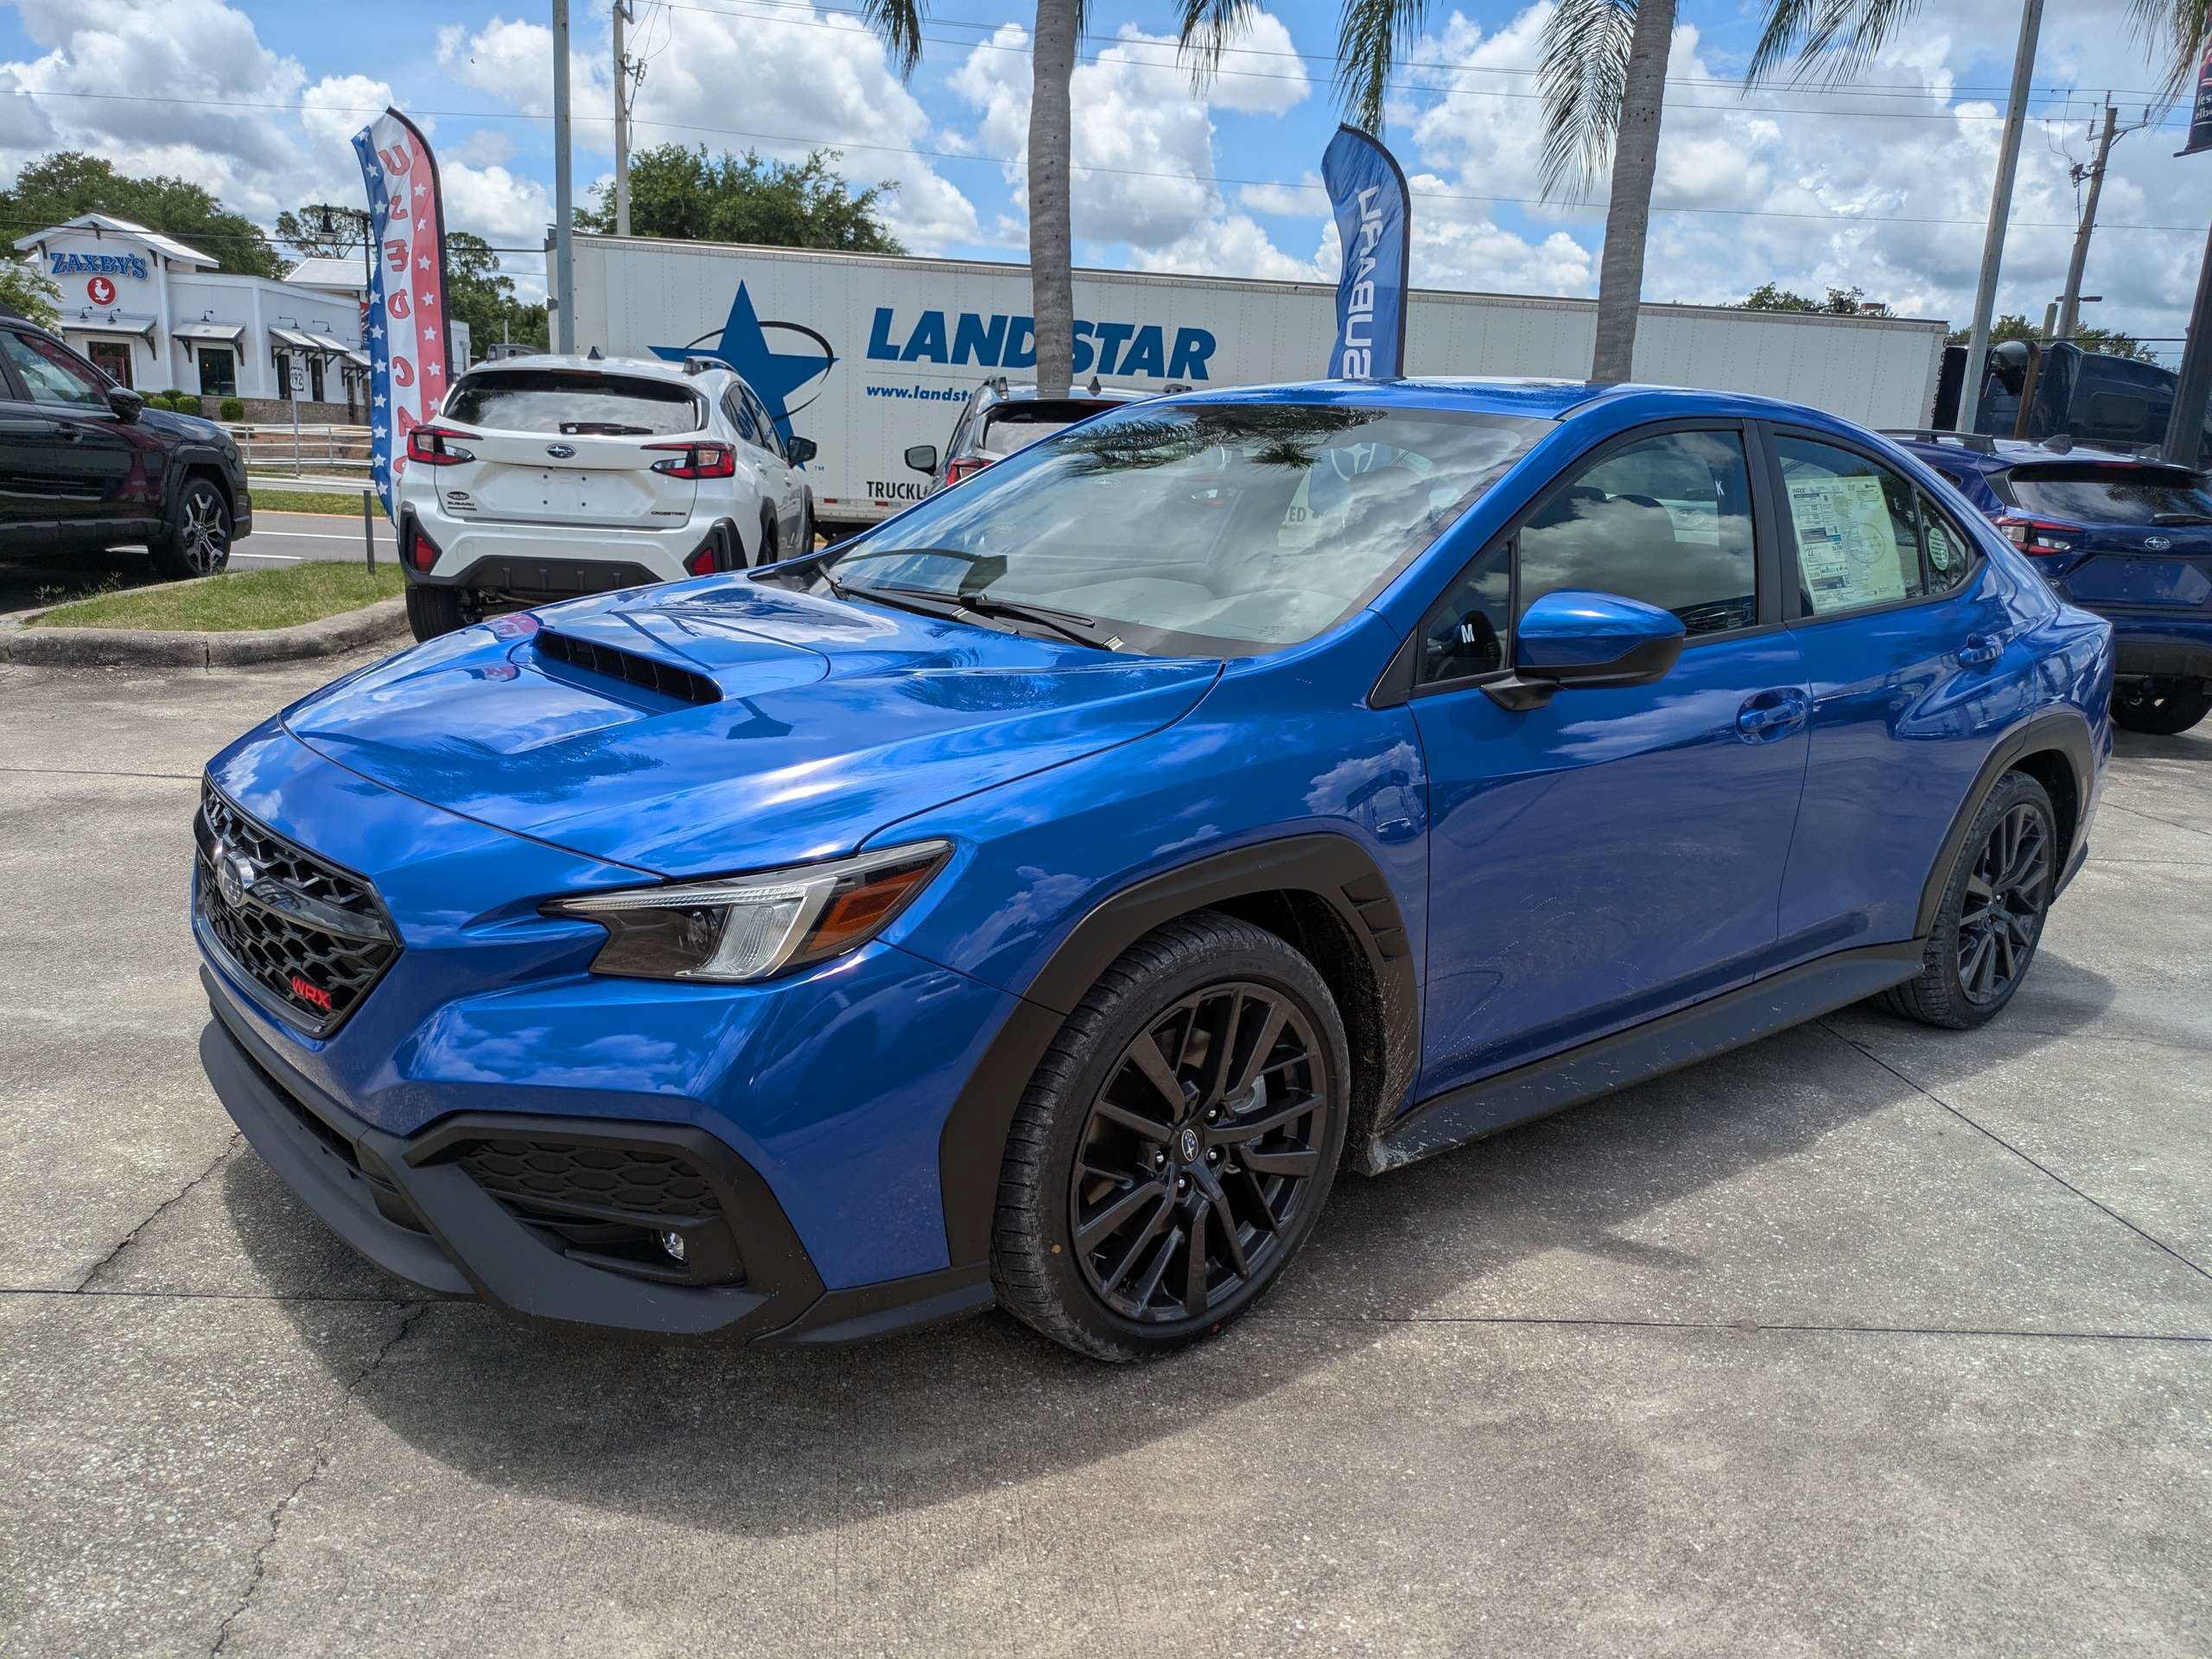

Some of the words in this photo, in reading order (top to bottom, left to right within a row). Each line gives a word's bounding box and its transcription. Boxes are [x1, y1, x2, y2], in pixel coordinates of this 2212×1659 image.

[49, 252, 148, 282] ZAXBY'S
[866, 307, 1217, 380] LANDSTAR
[291, 372, 303, 385] 192
[866, 480, 928, 500] TRUCKL
[290, 976, 332, 1010] WRX
